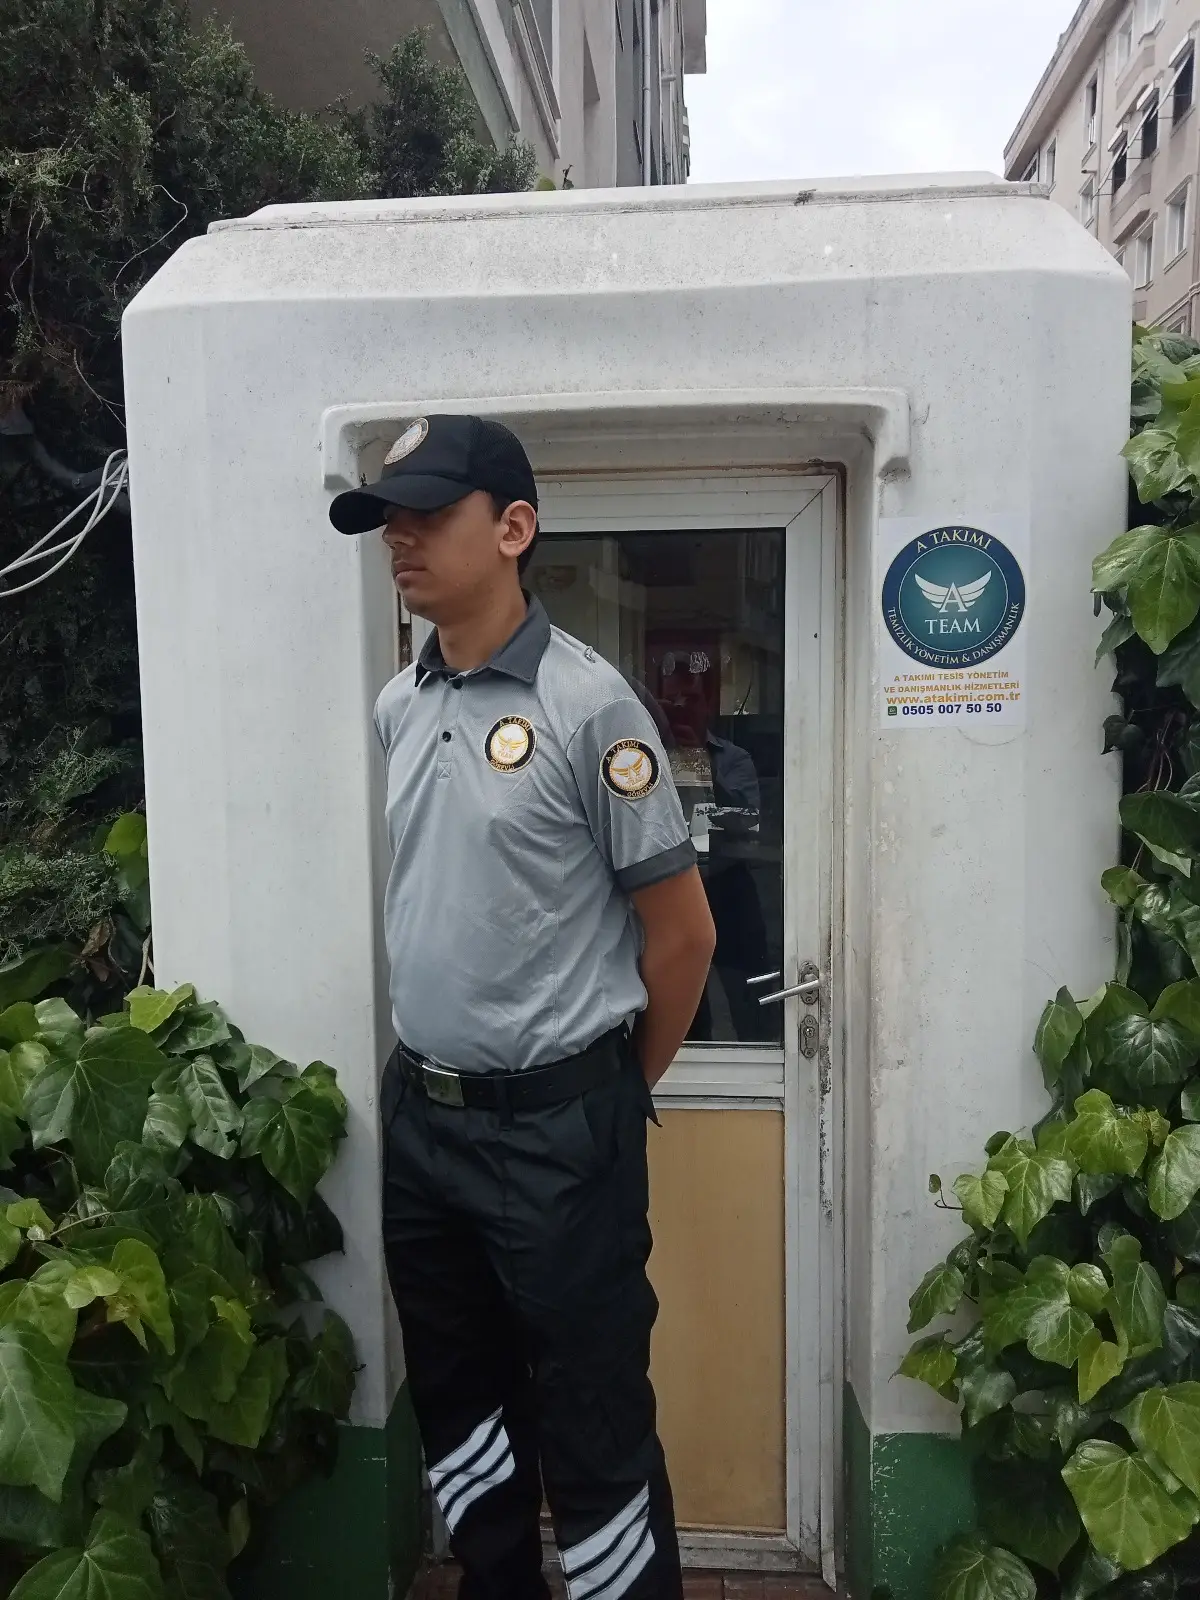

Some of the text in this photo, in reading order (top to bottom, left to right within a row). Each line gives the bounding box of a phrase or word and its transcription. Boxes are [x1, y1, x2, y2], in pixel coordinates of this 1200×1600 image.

[917, 529, 992, 553] A TAKIMI
[887, 602, 1020, 664] TEMİZLİK YÖNETİM & DANIŞMANLIK
[924, 617, 982, 635] TEAM
[902, 673, 935, 682] TAKIMI
[938, 671, 964, 681] TESİS
[966, 670, 1009, 679] YÖNETİM
[884, 680, 1020, 694] VE DANIŞMANLIK HİZMETLERİ
[886, 691, 1021, 705] www.atakimi.com.tr
[902, 702, 1002, 715] 0505 007 50 50
